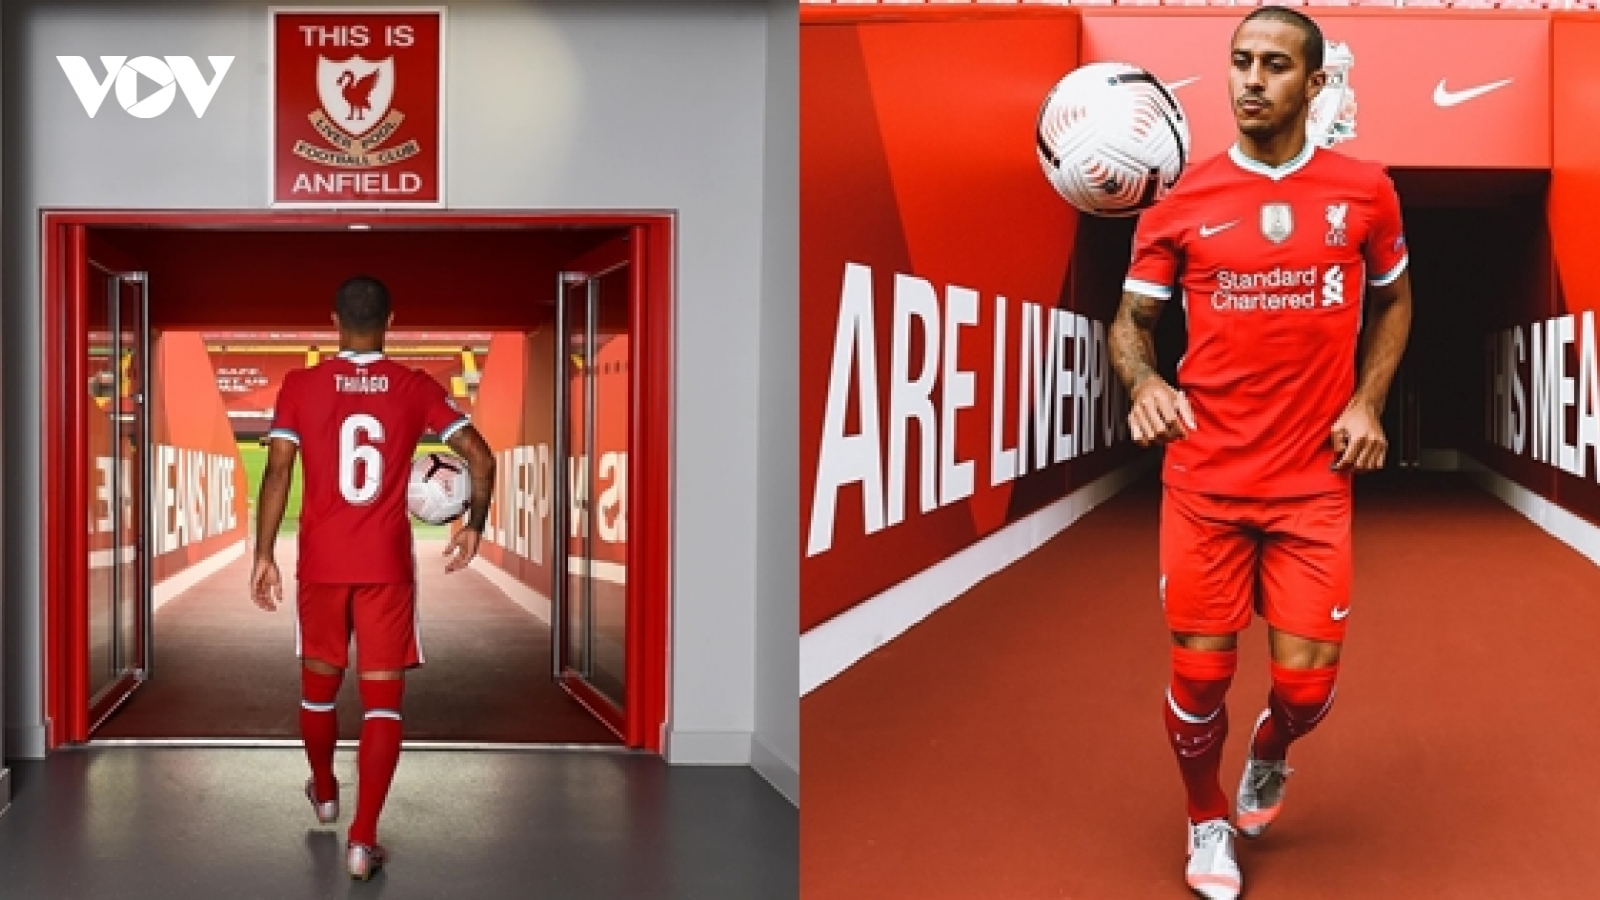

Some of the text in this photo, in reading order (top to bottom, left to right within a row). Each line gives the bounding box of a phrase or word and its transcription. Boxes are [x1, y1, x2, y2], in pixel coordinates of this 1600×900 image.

[298, 25, 415, 47] THIS IS
[297, 142, 416, 165] FOOTBALL CLUB
[291, 171, 422, 194] ANFIELD
[1216, 266, 1318, 289] Standard
[1210, 288, 1315, 311] Chartered
[333, 373, 389, 394] THIAGO
[805, 262, 1125, 558] ARE LIVERPO
[338, 412, 386, 505] 6
